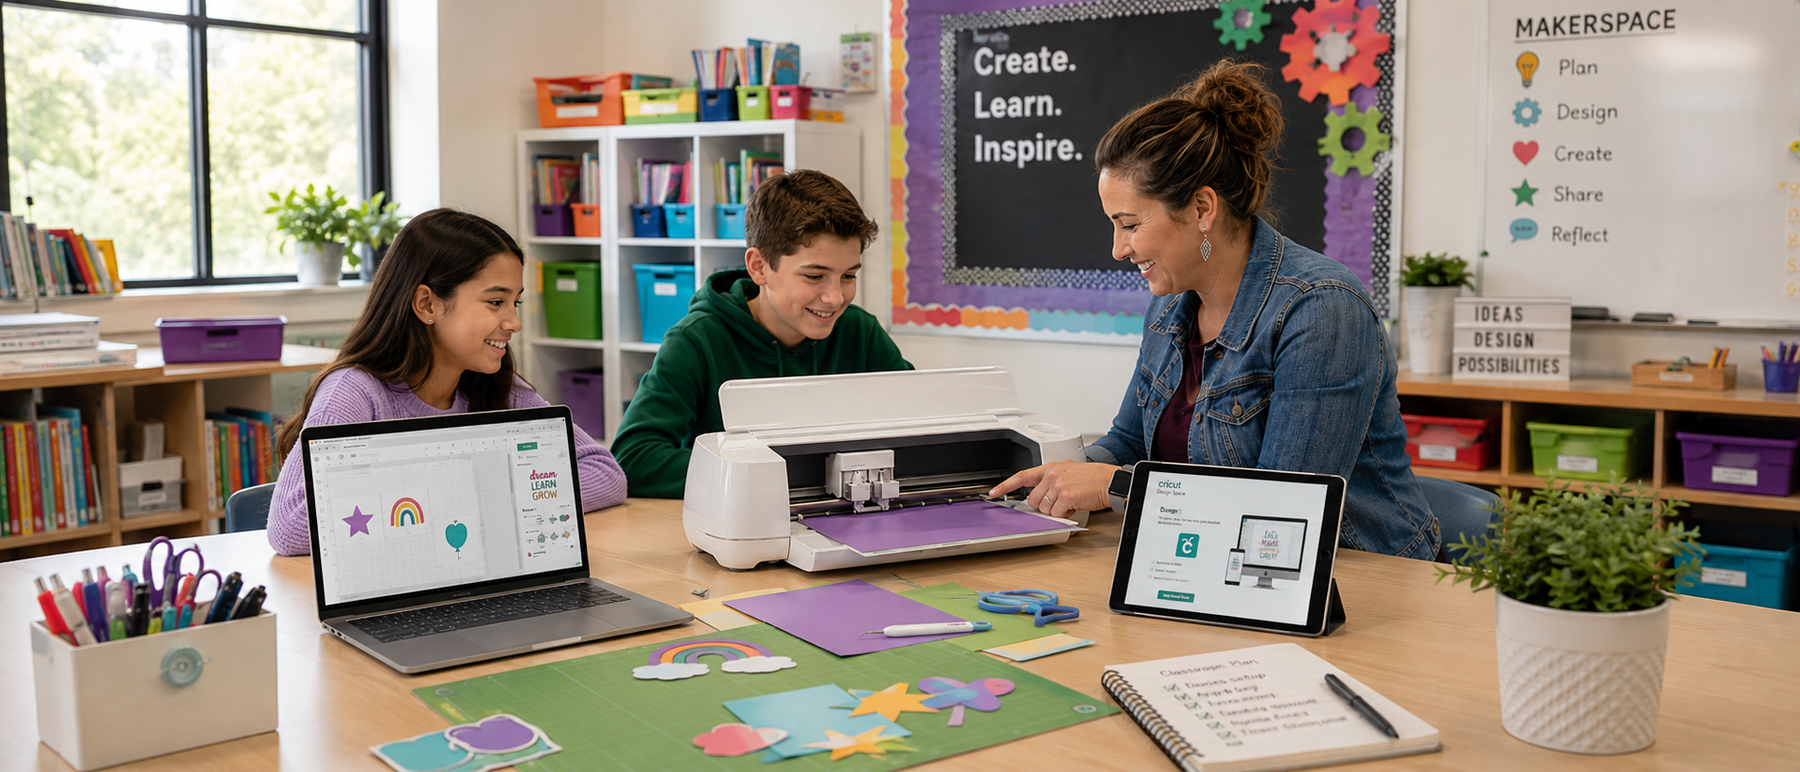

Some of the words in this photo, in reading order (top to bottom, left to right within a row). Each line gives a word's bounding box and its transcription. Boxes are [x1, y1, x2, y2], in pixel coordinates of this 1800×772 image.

[1515, 8, 1676, 38] MAKERSPACE
[974, 46, 1077, 76] Create.
[1559, 58, 1598, 76] Plan
[974, 91, 1062, 119] Learn.
[1557, 103, 1618, 125] Design
[974, 132, 1083, 169] Inspire.
[1554, 145, 1613, 162] Create
[1554, 185, 1604, 202] Share
[1552, 226, 1608, 247] Reflect
[1475, 306, 1524, 322] IDEAS
[1474, 332, 1534, 348] DESIGN
[1458, 356, 1560, 374] POSSIBILITIES
[530, 469, 558, 480] dream
[531, 479, 557, 491] LEARN
[1158, 479, 1182, 489] cricut
[532, 490, 558, 501] GROW
[1229, 659, 1259, 667] Plan
